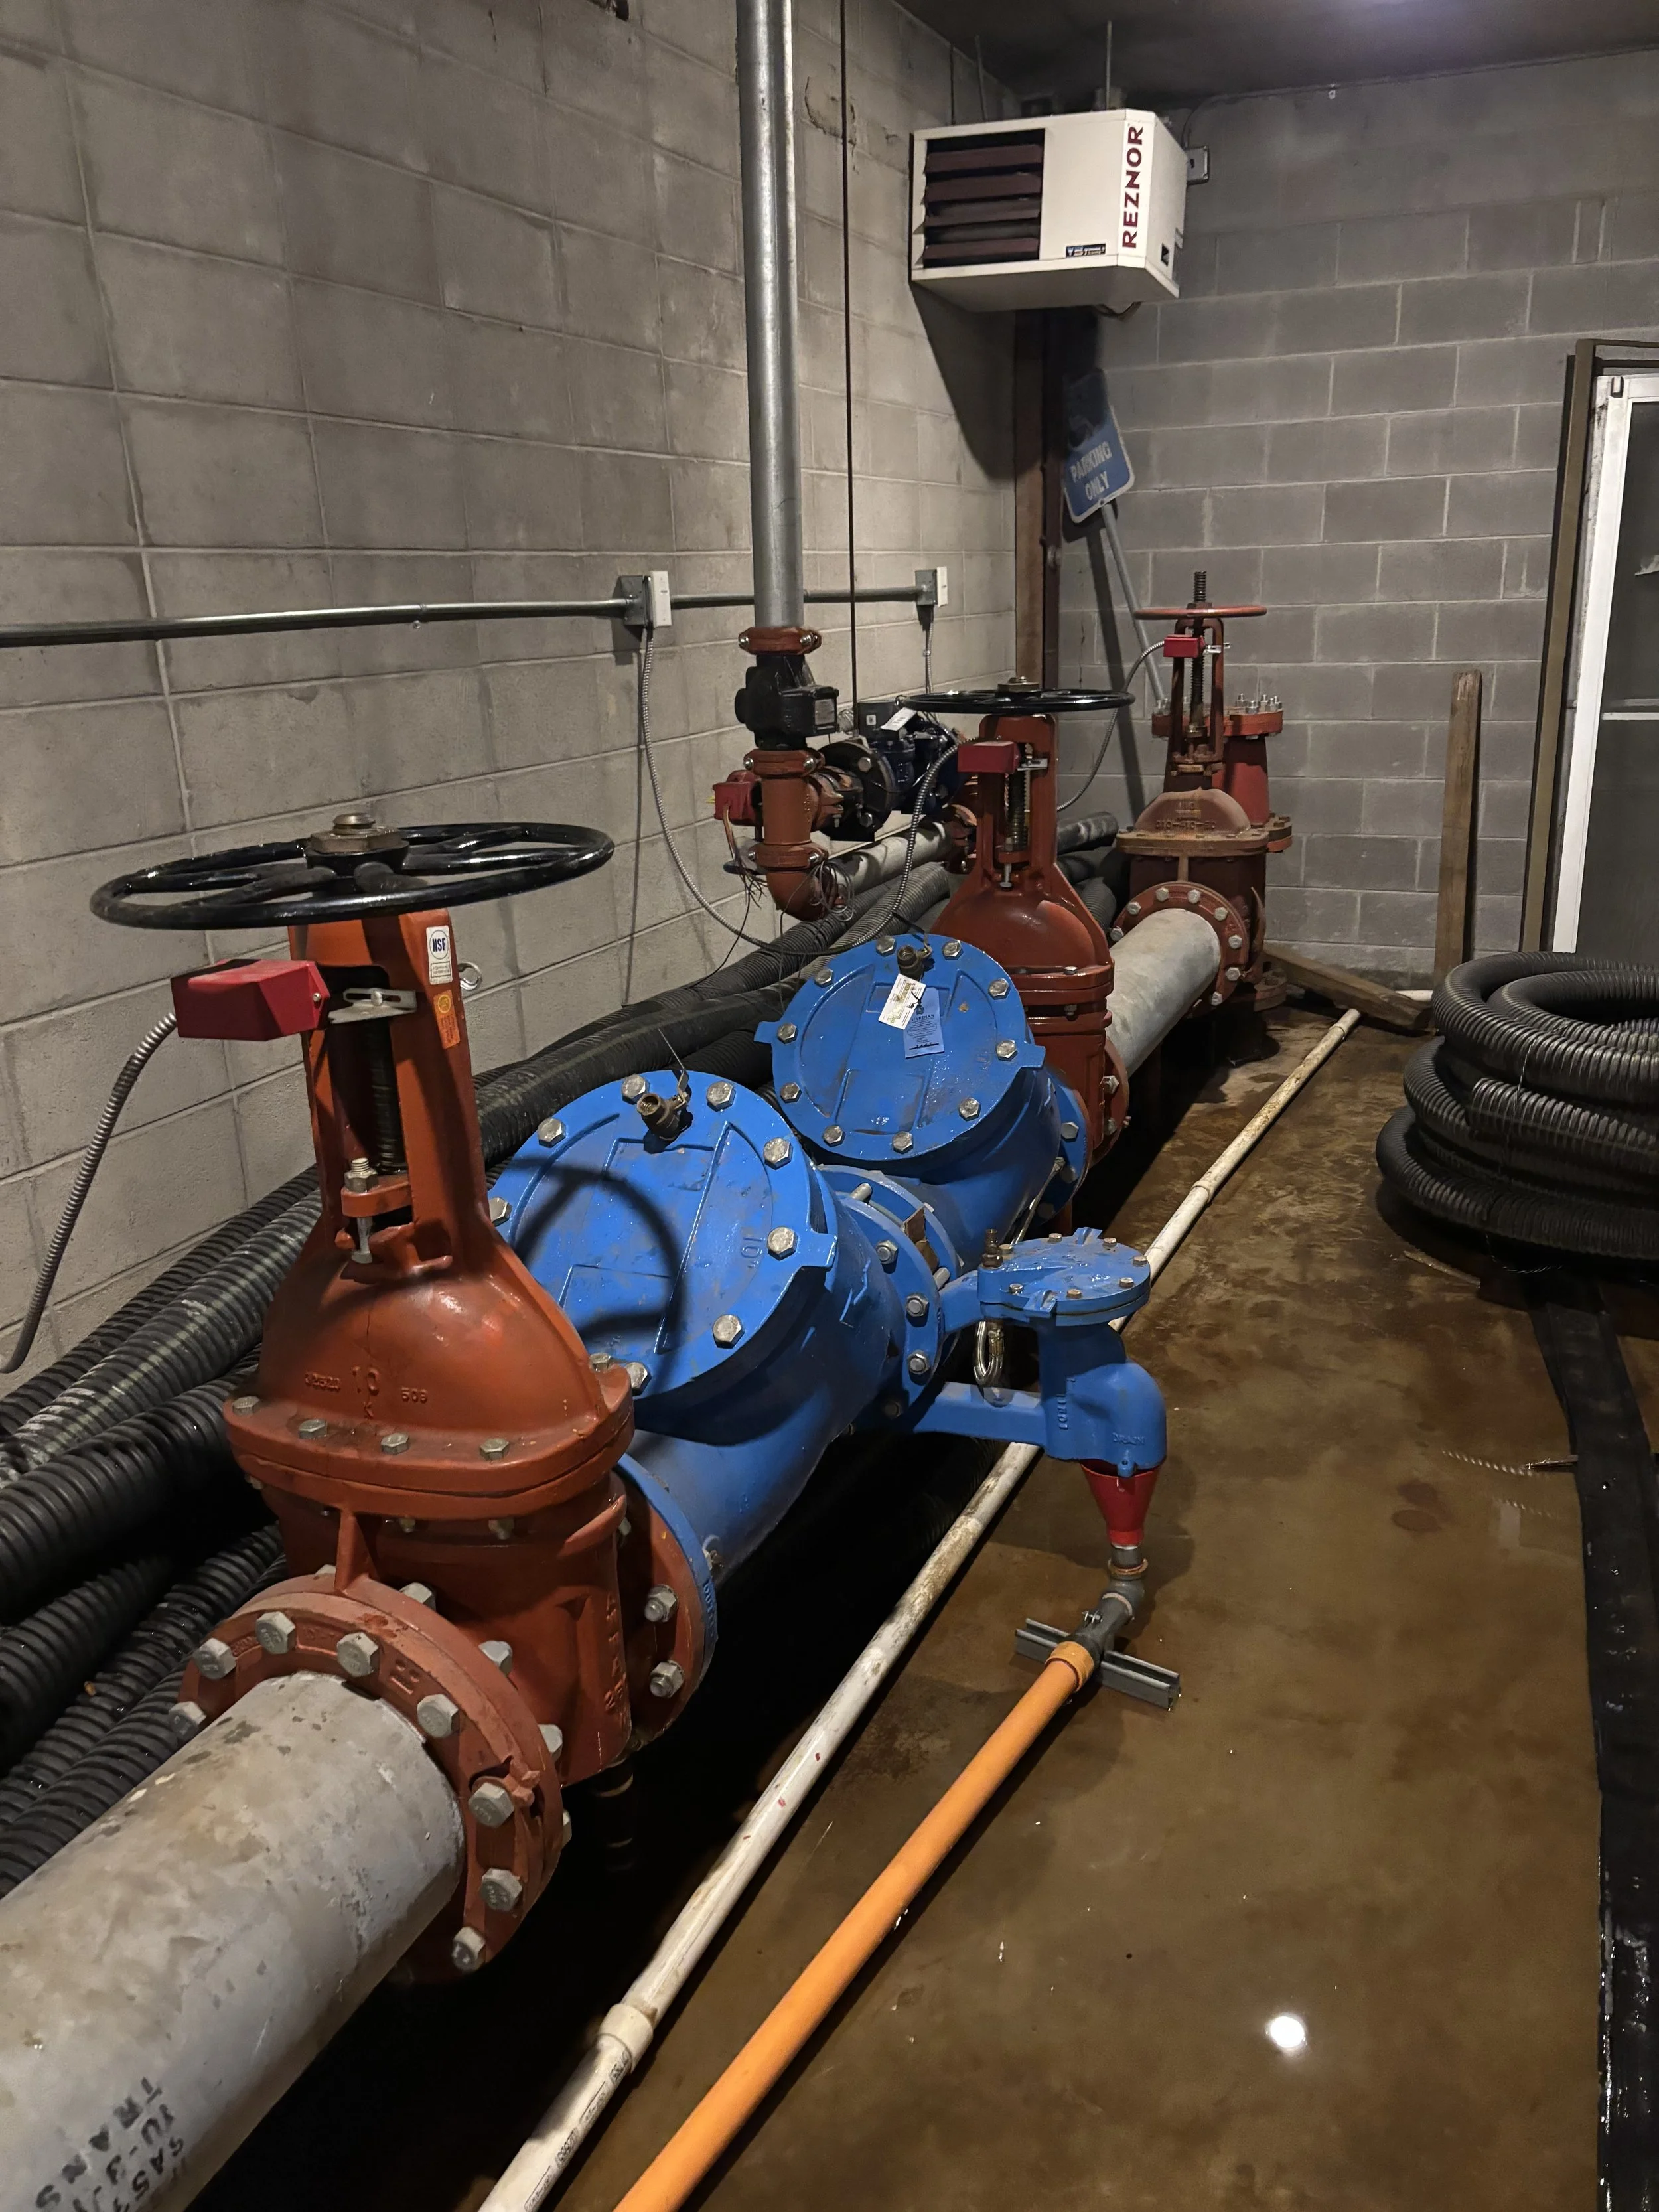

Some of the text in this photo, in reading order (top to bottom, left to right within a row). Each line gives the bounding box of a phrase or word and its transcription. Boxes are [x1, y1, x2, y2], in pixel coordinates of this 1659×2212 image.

[1121, 125, 1144, 249] REZNOR
[1070, 441, 1112, 483] PARKING
[1084, 471, 1110, 501] ONLY
[432, 938, 446, 953] NSF
[910, 1014, 935, 1023] UARDIAN
[36, 2076, 163, 2209] TRANS
